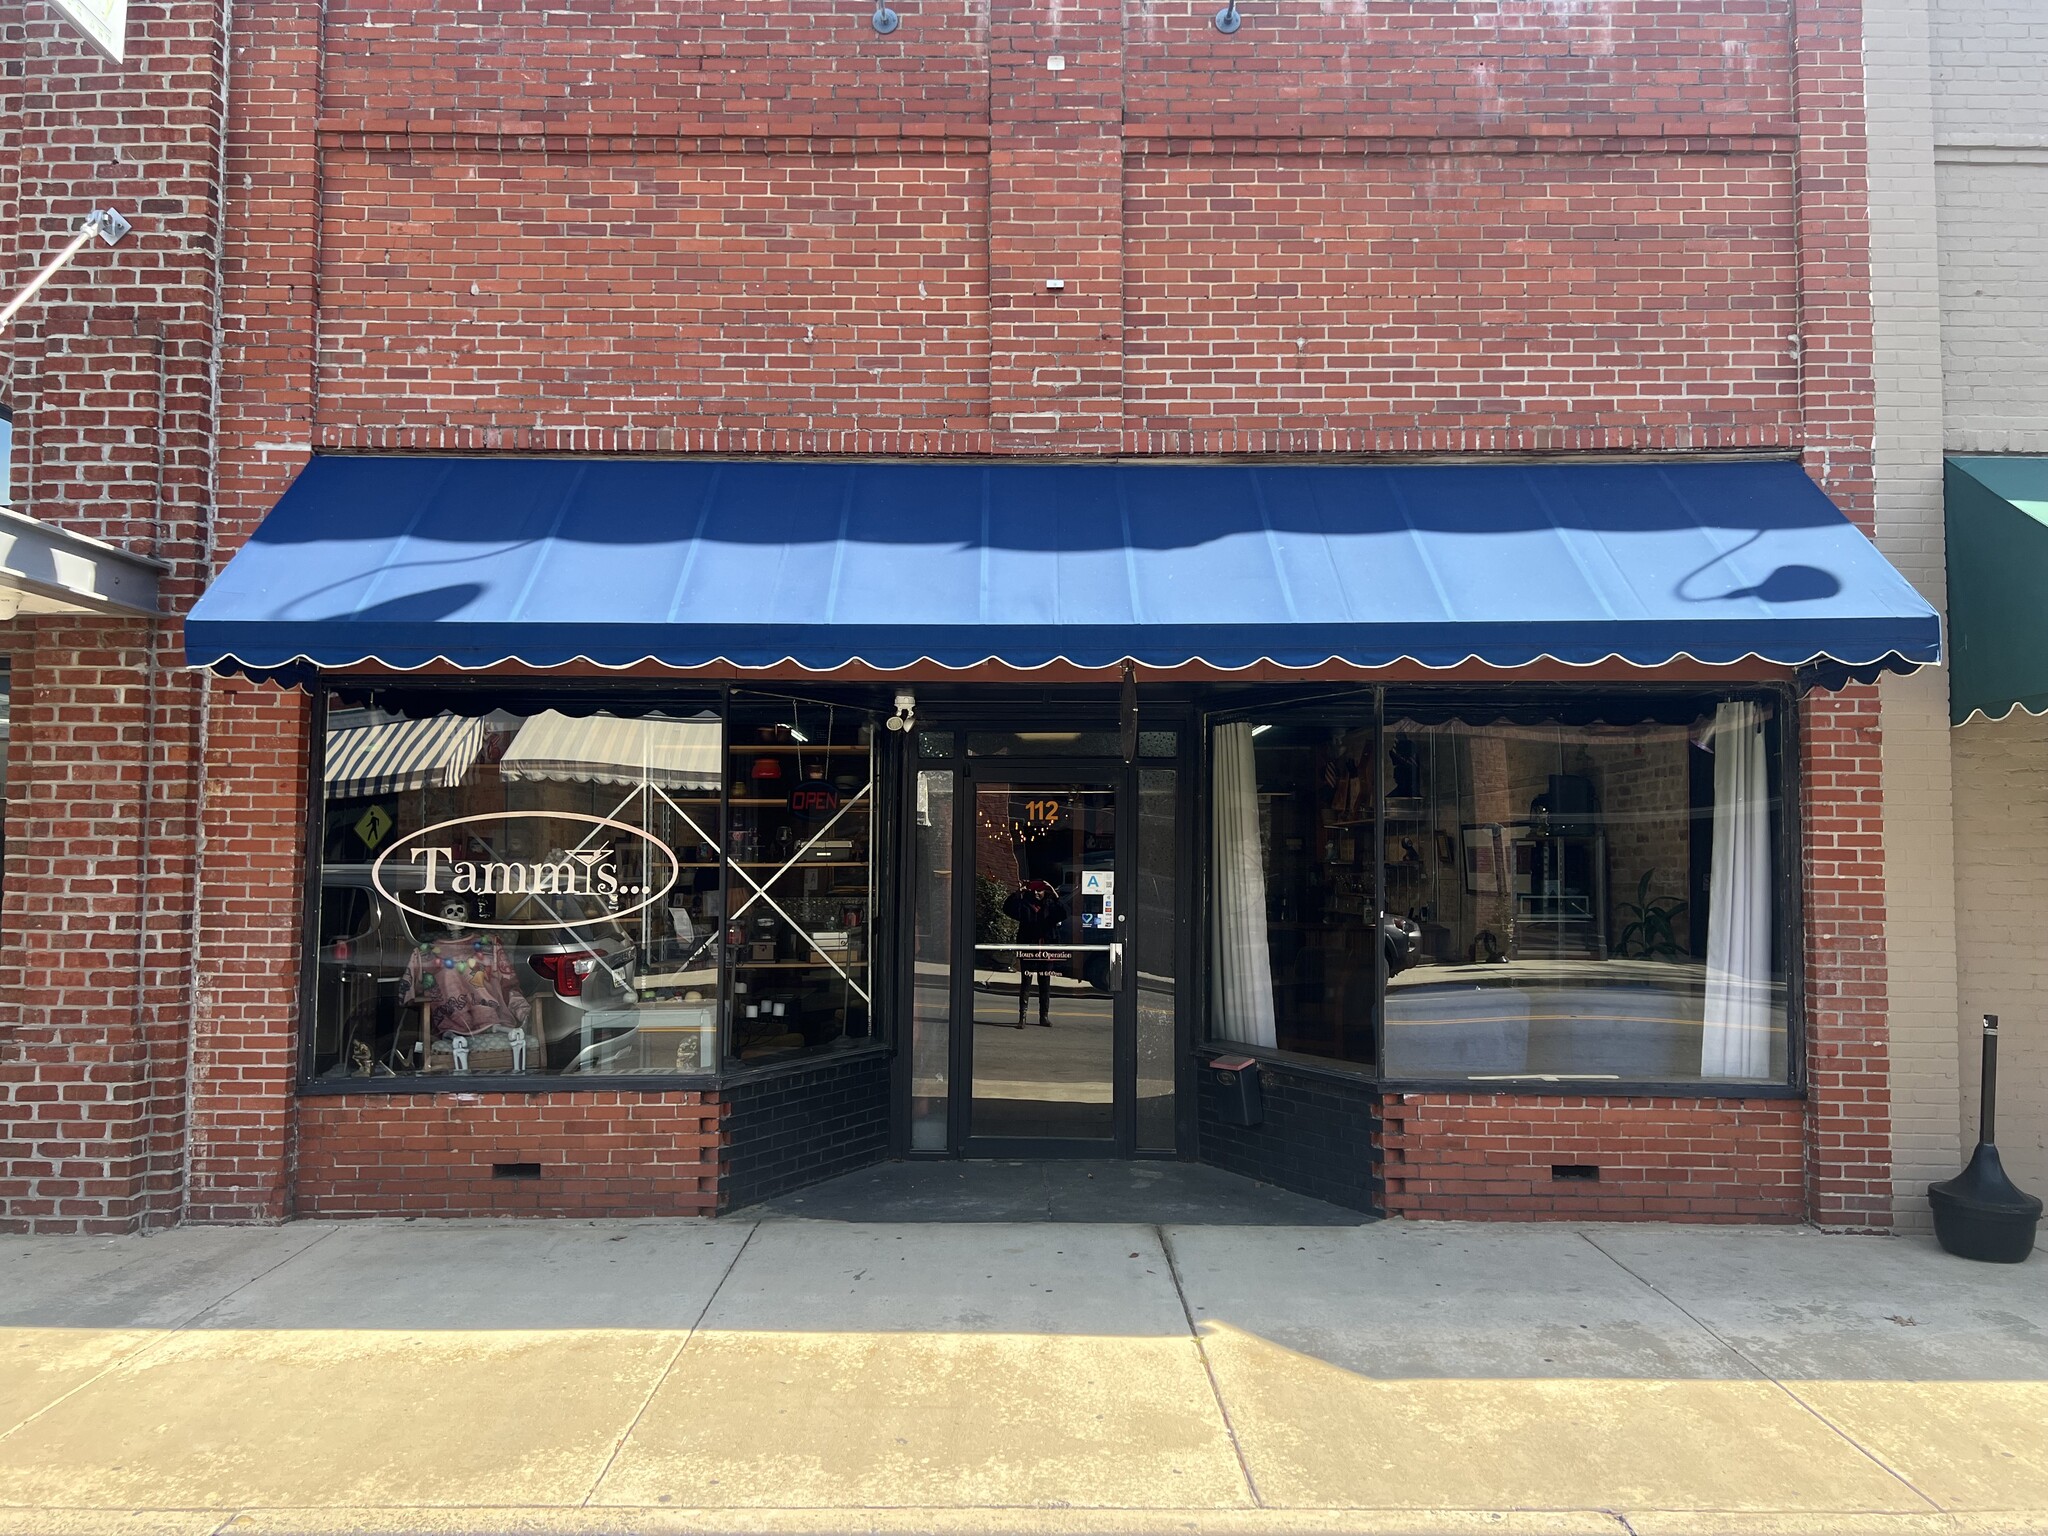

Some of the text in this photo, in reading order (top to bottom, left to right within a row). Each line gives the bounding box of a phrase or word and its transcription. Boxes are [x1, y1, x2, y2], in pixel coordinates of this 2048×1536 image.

[793, 791, 838, 810] OPEN
[1025, 800, 1059, 821] 112
[1087, 875, 1099, 888] A
[1016, 950, 1072, 960] Hours of Operation
